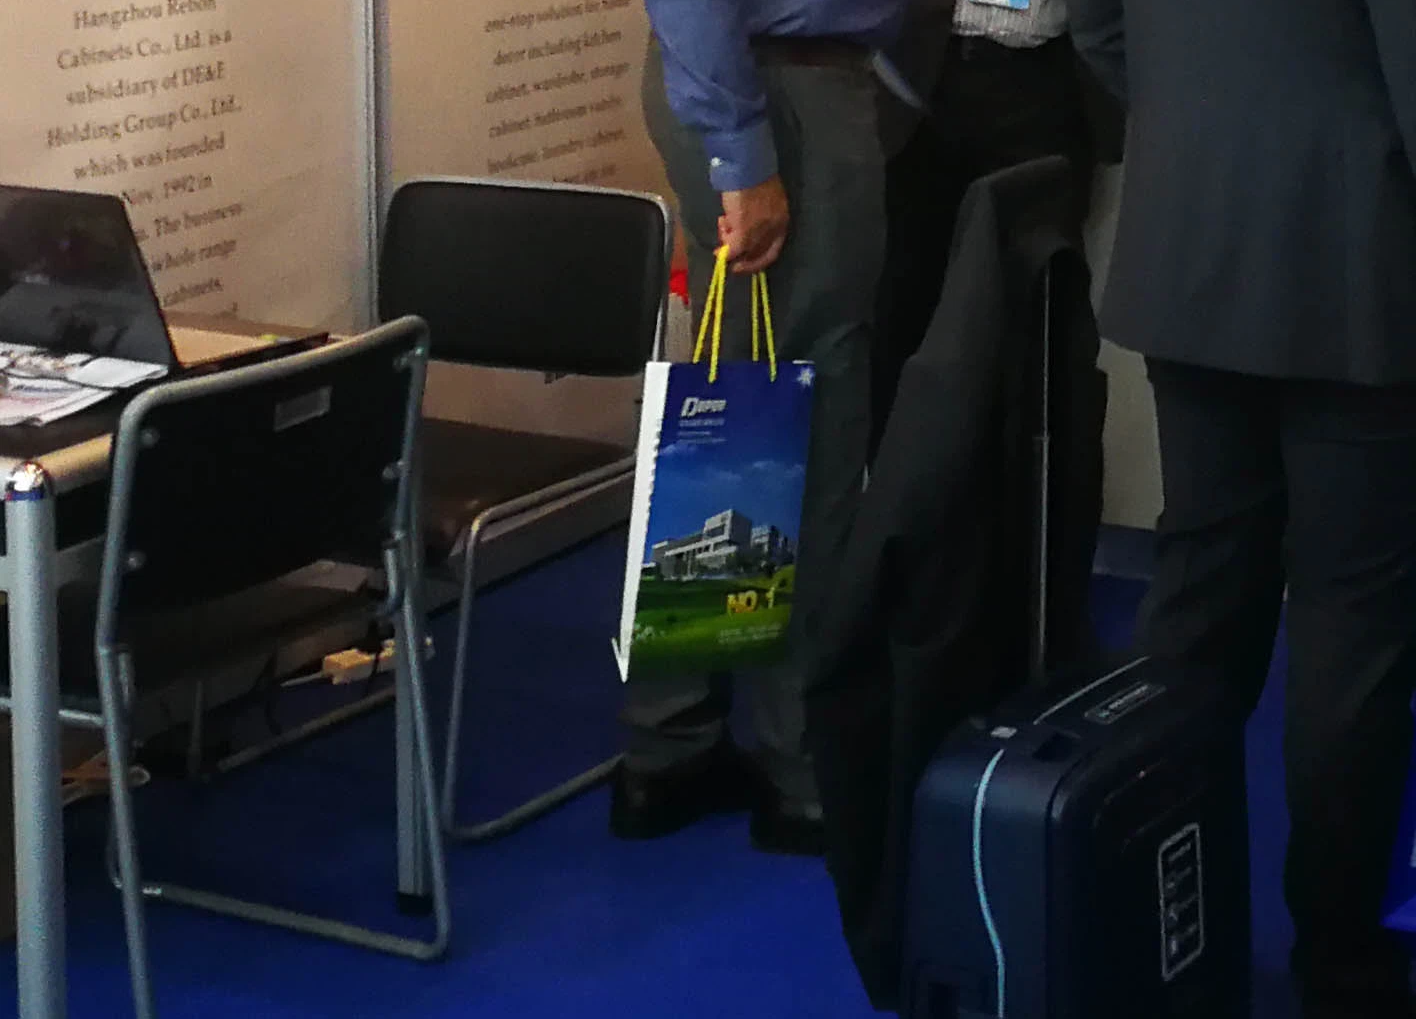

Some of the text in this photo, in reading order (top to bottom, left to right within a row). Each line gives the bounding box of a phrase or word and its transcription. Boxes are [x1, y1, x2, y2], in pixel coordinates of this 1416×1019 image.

[73, 2, 163, 30] Hangzhou
[56, 43, 134, 70] Cabinets
[65, 79, 158, 105] subsidiary
[47, 121, 121, 149] Holding
[123, 111, 177, 133] Group
